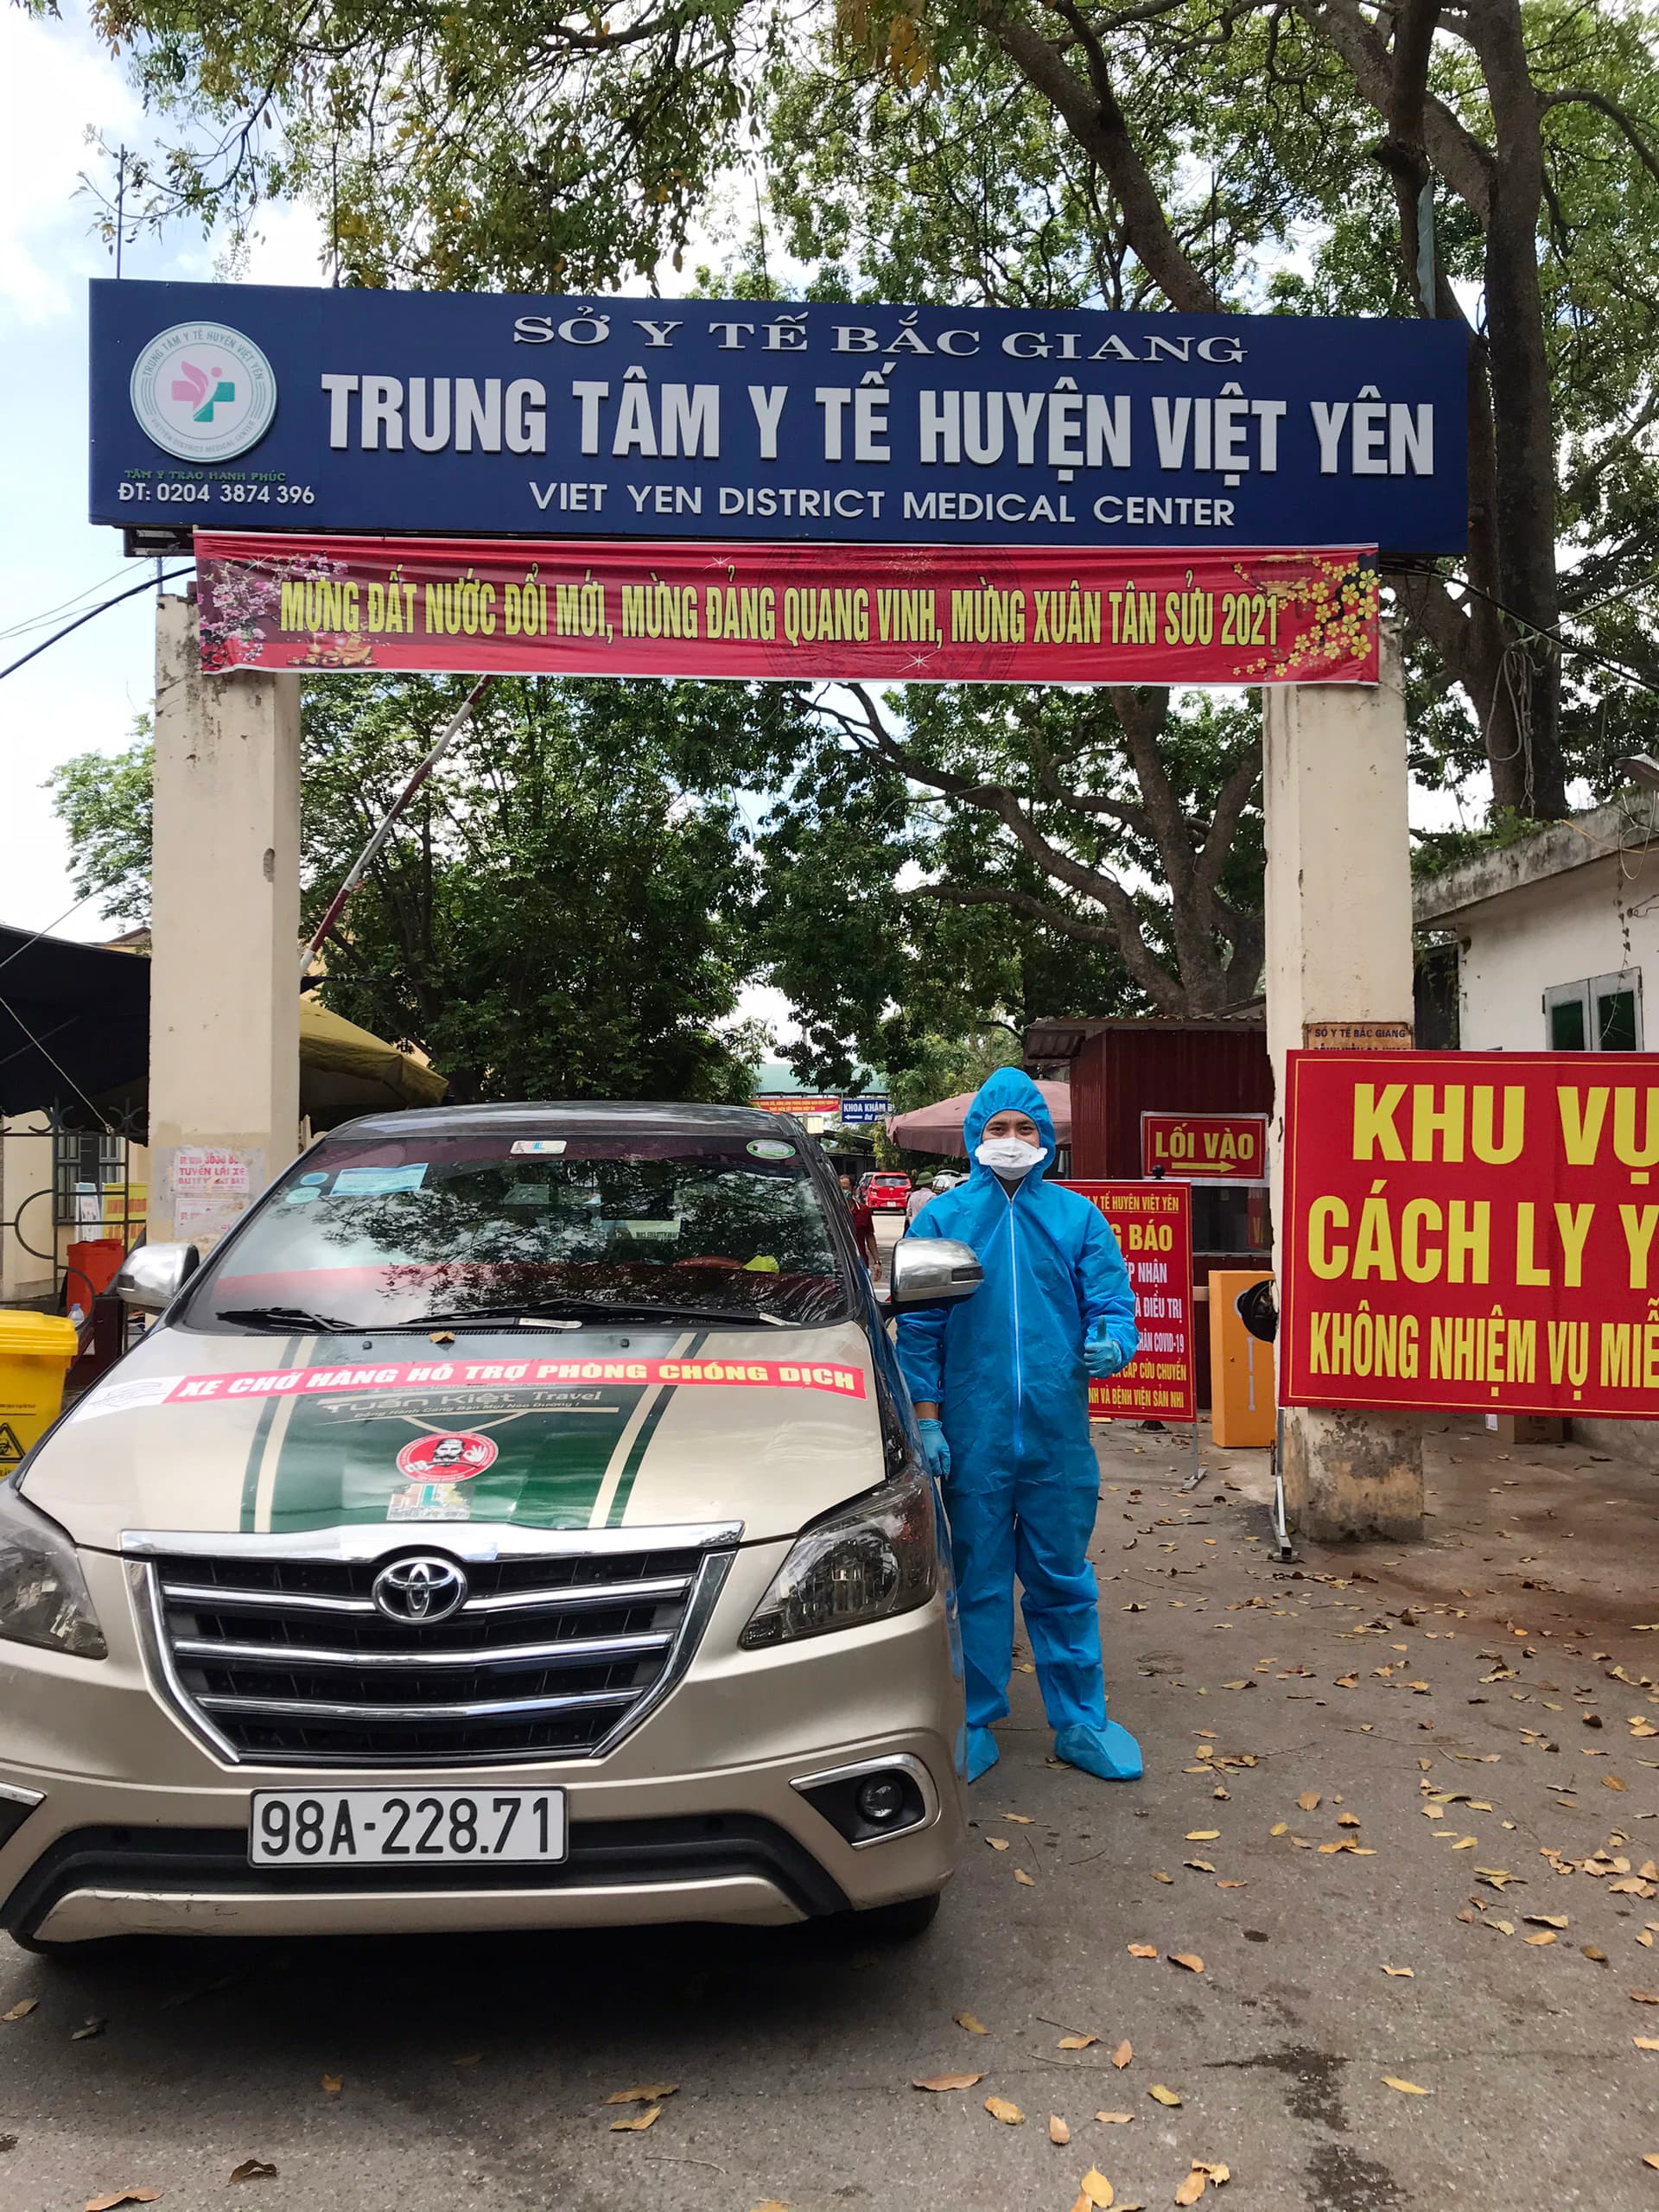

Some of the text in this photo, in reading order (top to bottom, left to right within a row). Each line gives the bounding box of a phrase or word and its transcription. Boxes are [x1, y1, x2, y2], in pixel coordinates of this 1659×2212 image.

[513, 305, 1249, 364] SỞ Y TẾ BẮC GIANG
[143, 328, 264, 379] TRUNG TÂM Y TẾ HUYỆN VIỆT YÊN
[321, 361, 1434, 487] TRUNG TÂM Y TẾ HUYỆN VIỆT YÊN
[168, 470, 204, 480] TRAO
[251, 470, 287, 481] PHÚC
[118, 483, 315, 504] ĐT: 0204 3874 396
[529, 481, 1236, 526] VIET YEN DISTRICT MEDICAL CENTER
[280, 562, 1278, 649] MỪNG ĐẤT NƯỚC ĐỔI MỚI, MỪNG ĐẢNG QUANG VINH, MỪNG XUÂN TÂN SỬU 2021
[1314, 1026, 1327, 1037] SỞ
[843, 1103, 863, 1112] KHOA
[1352, 1084, 1525, 1165] KHU
[1155, 1123, 1254, 1160] LỐI VÀO
[1100, 1191, 1110, 1210] TẾ
[1112, 1193, 1140, 1213] HUYỆN
[1141, 1193, 1160, 1213] VIỆT
[1161, 1194, 1179, 1211] YÊN
[1129, 1219, 1173, 1251] BÁO
[1308, 1179, 1659, 1289] CÁCH LY Y
[1138, 1258, 1167, 1287] NHẬN
[1144, 1289, 1165, 1319] ĐIỀU
[1166, 1298, 1182, 1323] TRỊ
[1154, 1332, 1185, 1353] COVID-19
[1309, 1300, 1419, 1378] KHÔNG
[1430, 1305, 1536, 1396] NHIỆM
[1548, 1321, 1589, 1401] VỤ
[176, 1361, 855, 1397] XE CHỞ HÀNG HỖ TRỢ PHÒNG CHỐNG DỊCH
[1157, 1357, 1186, 1382] CHUYỂN
[532, 1390, 602, 1402] Travel
[1101, 1384, 1110, 1404] VÀ
[1112, 1386, 1132, 1408] BỆNH
[1134, 1387, 1151, 1409] VIỆN
[1153, 1383, 1168, 1408] SẢN
[1171, 1392, 1184, 1408] NHI
[261, 1797, 549, 1856] 98A-228.71
